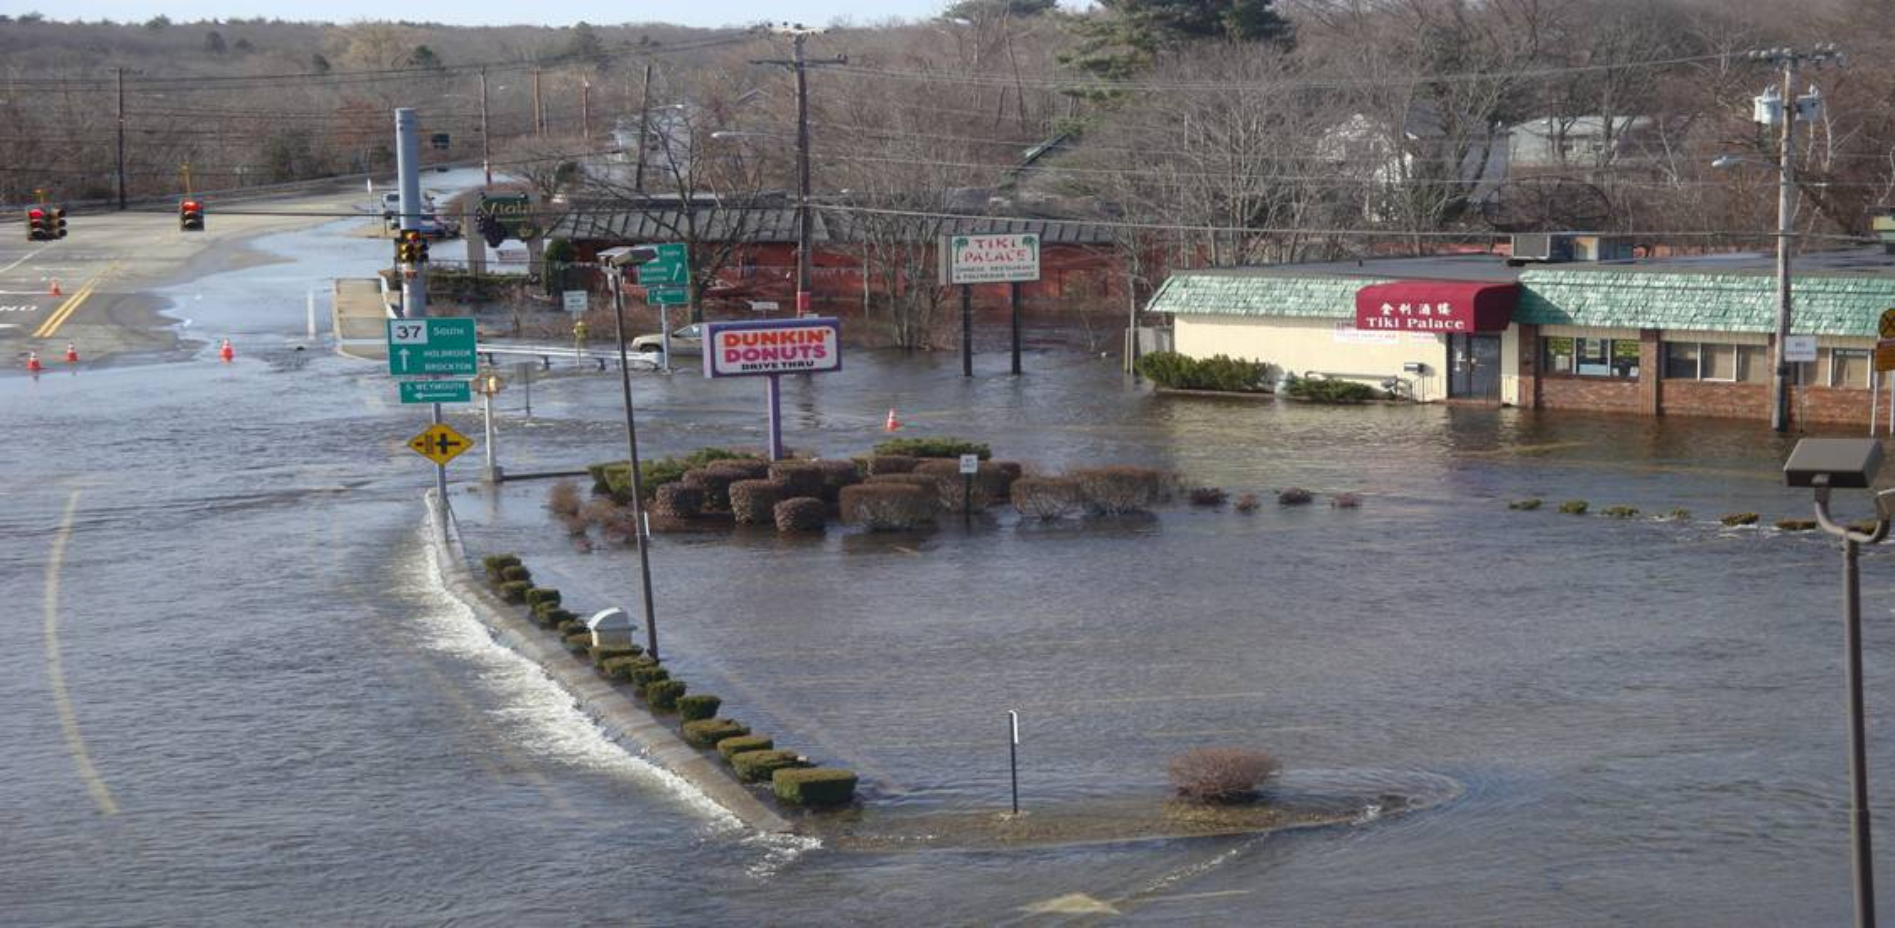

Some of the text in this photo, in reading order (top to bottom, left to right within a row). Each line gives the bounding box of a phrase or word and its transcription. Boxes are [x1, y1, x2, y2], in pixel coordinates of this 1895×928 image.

[972, 238, 1015, 249] TIKI
[965, 249, 1026, 263] PALACE
[1366, 317, 1399, 328] Tiki
[1407, 317, 1464, 330] Palace
[397, 325, 421, 339] 37
[723, 329, 831, 347] DUNKIN'
[724, 345, 827, 363] DONUTS
